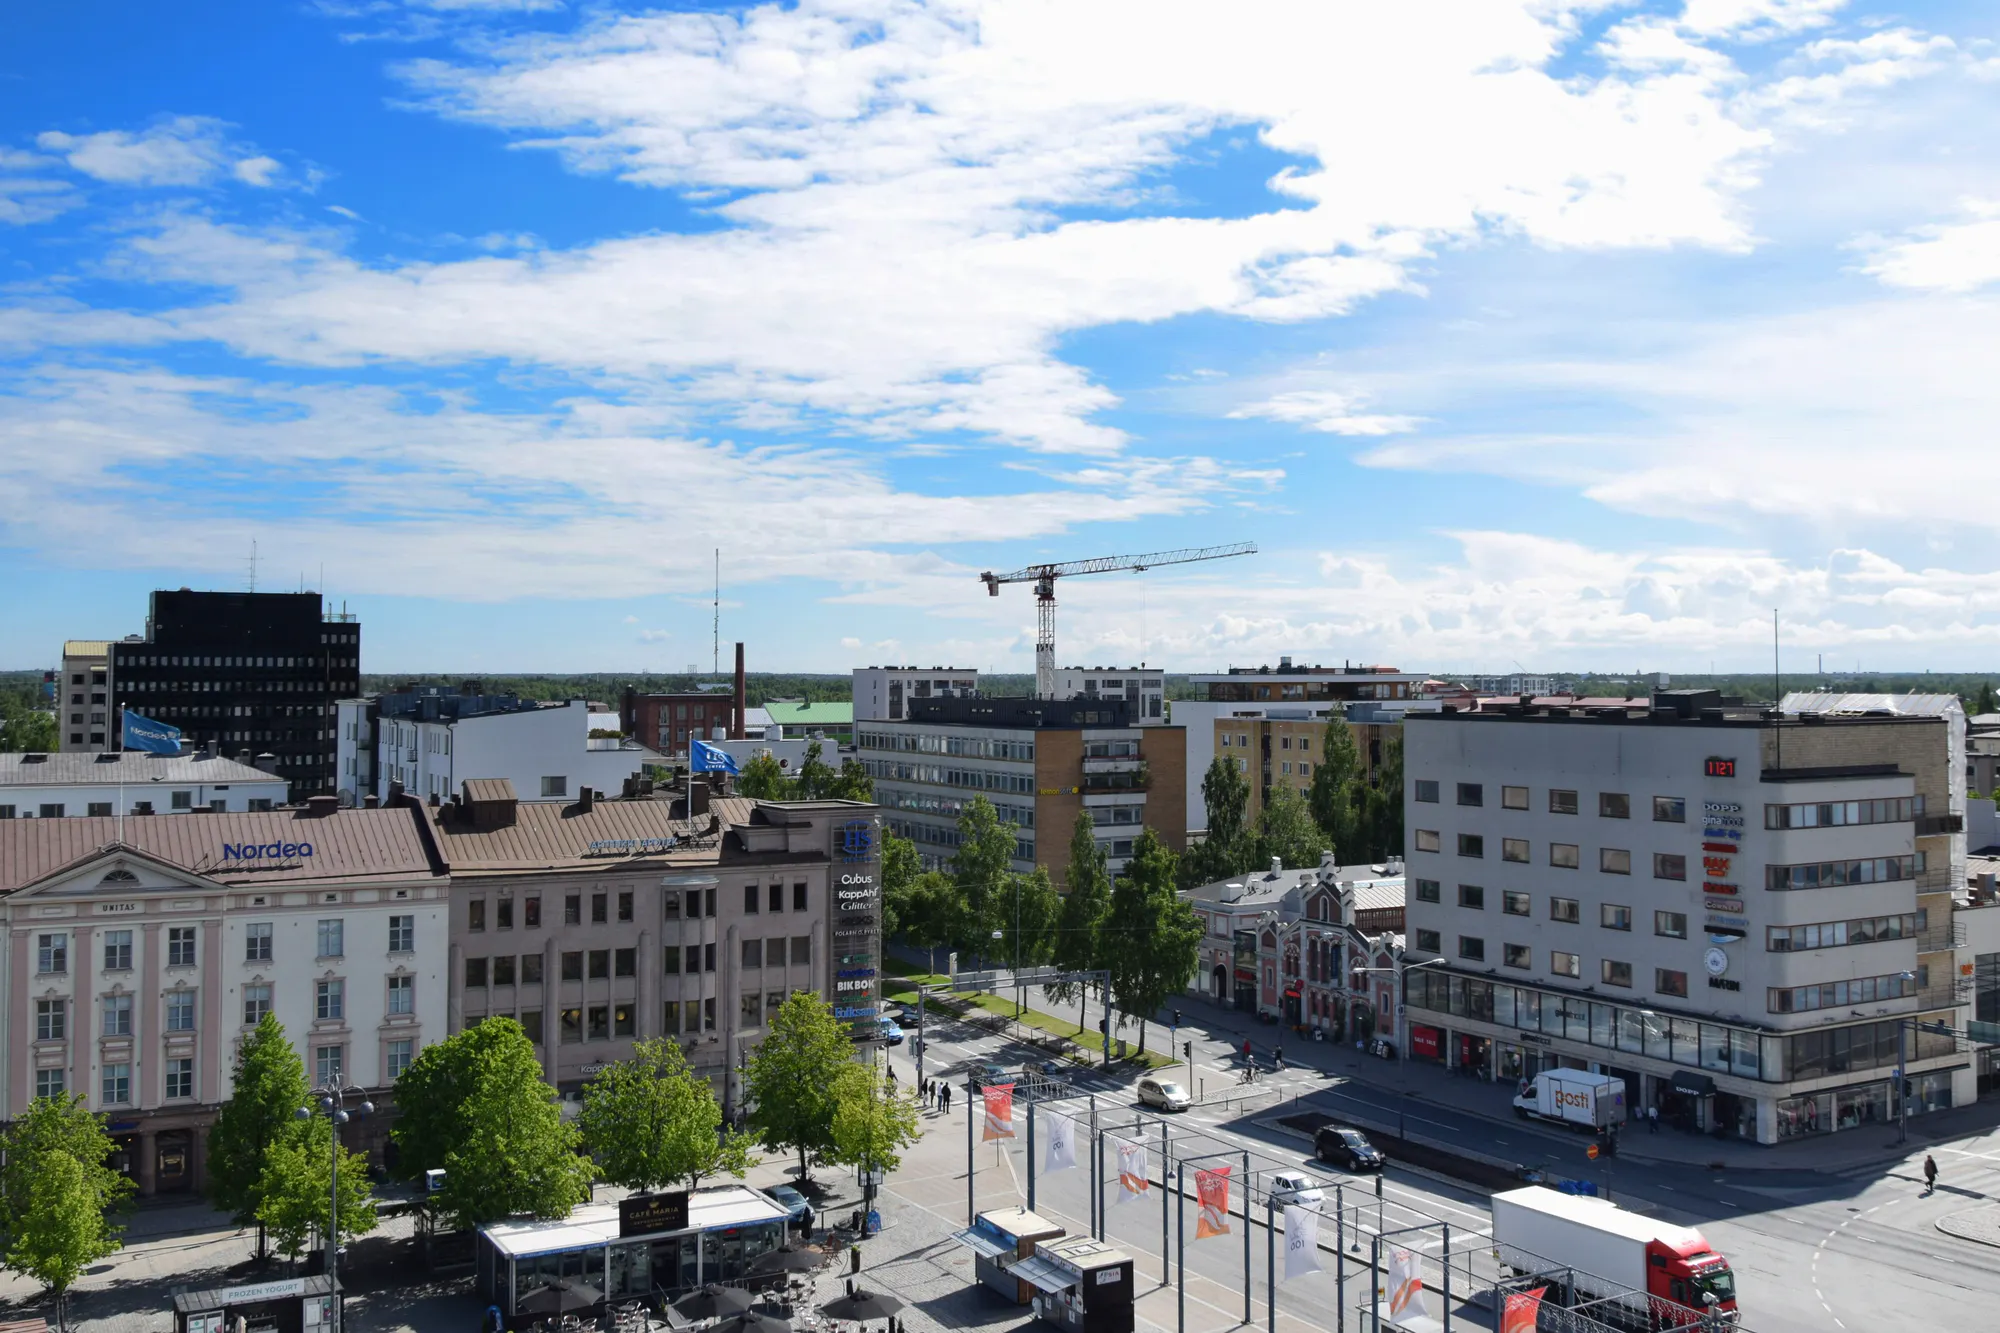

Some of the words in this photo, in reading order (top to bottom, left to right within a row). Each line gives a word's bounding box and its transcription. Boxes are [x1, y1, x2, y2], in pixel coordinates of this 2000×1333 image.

[130, 726, 168, 740] Nordea
[1703, 803, 1739, 812] DOPP
[223, 840, 313, 860] Nordea
[841, 873, 873, 885] Cubus
[102, 903, 136, 911] UNITAS
[841, 901, 873, 911] Glitter
[837, 981, 854, 992] BIK
[855, 979, 875, 990] BOK
[834, 1006, 878, 1019] Folksam
[1676, 1086, 1700, 1095] DOPP
[1555, 1090, 1589, 1110] posti
[629, 1209, 651, 1219] CAFÉ
[653, 1206, 679, 1216] MARIA
[228, 1288, 263, 1299] FROZEN
[265, 1283, 299, 1294] YOGURT
